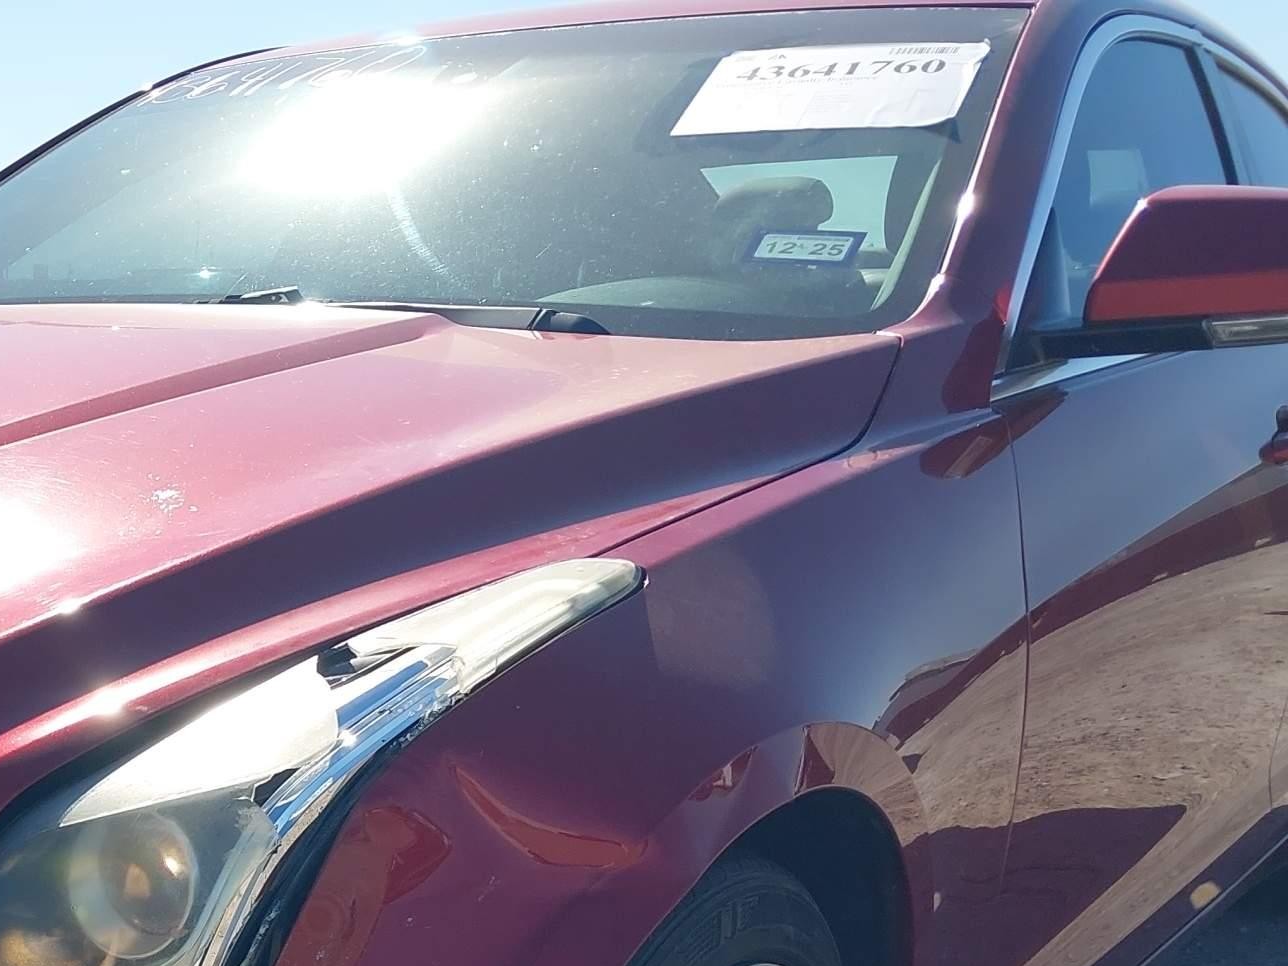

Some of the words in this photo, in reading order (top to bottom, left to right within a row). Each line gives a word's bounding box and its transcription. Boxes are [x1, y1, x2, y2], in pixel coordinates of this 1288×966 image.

[736, 58, 947, 82] 43641760
[765, 241, 798, 255] 12
[807, 243, 846, 257] 25
